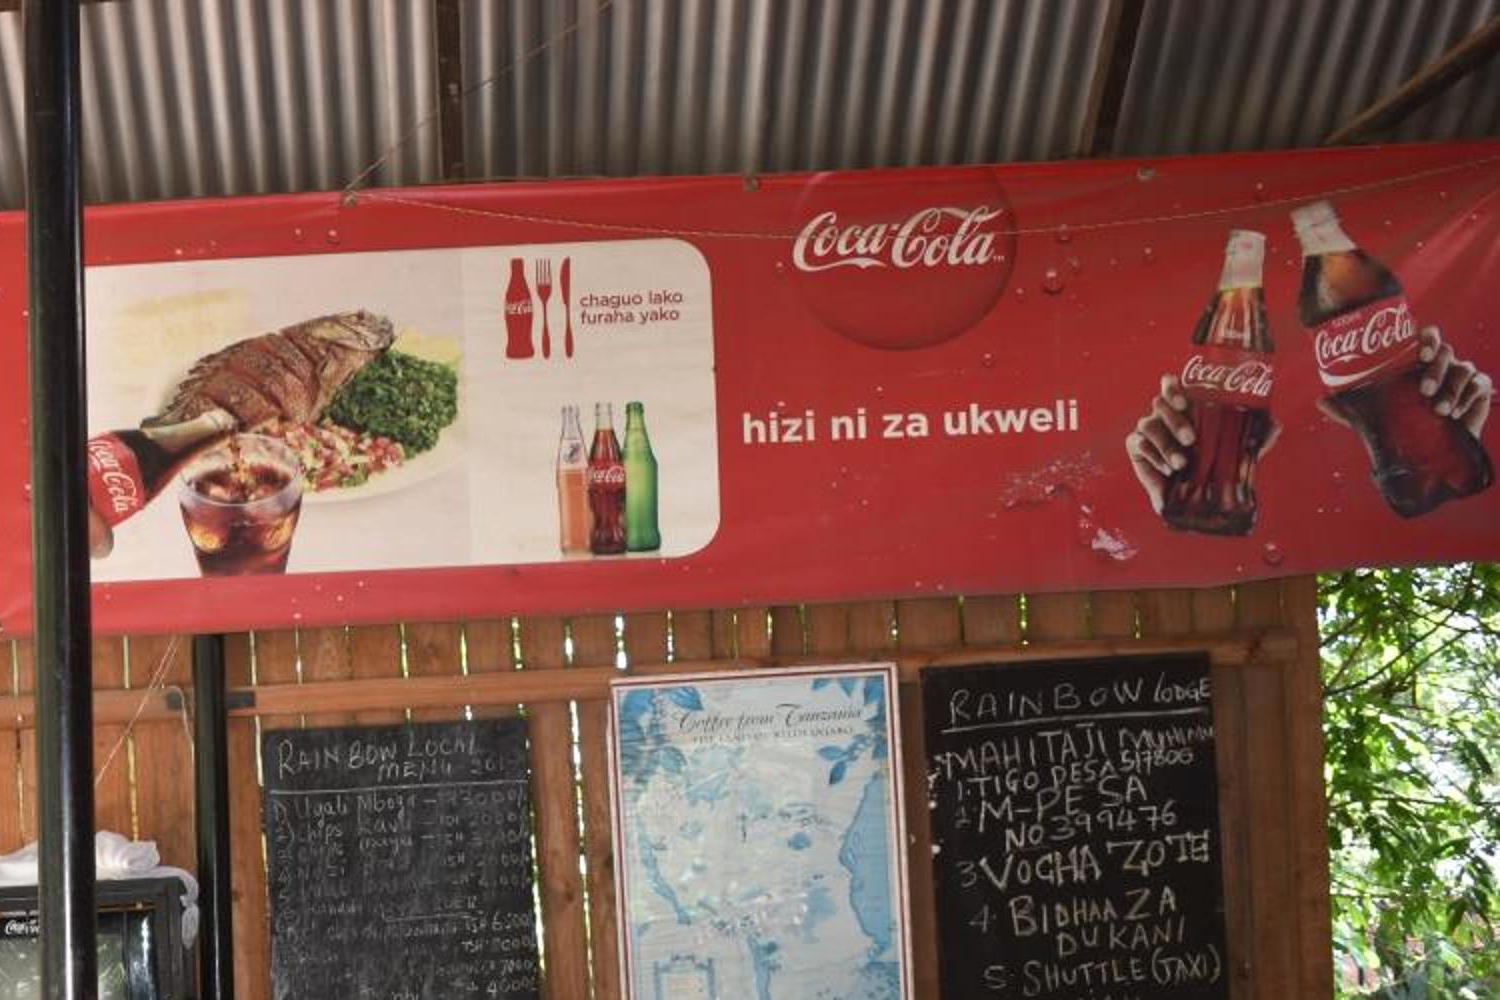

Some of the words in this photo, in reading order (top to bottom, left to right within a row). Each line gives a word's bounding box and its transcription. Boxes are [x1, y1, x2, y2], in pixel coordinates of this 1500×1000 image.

[793, 205, 1004, 272] Coca-Cola
[580, 293, 642, 309] chaguo
[648, 290, 683, 304] lako
[580, 309, 634, 325] furaha
[639, 307, 680, 325] yako
[1315, 303, 1414, 369] Coca-Cola
[1181, 354, 1275, 397] Coca-Cola
[742, 409, 816, 444] hizi
[831, 407, 867, 441] ni
[882, 412, 930, 439] za
[943, 399, 1079, 436] ukweli
[736, 712, 775, 731] from
[776, 703, 861, 728] Tanzania
[966, 767, 1040, 797] TIGO
[1050, 759, 1120, 790] PESA
[1004, 822, 1045, 853] NO
[1049, 799, 1178, 841] 399476
[1020, 957, 1148, 998] SHUTTLE
[1151, 942, 1222, 986] (TAXI)
